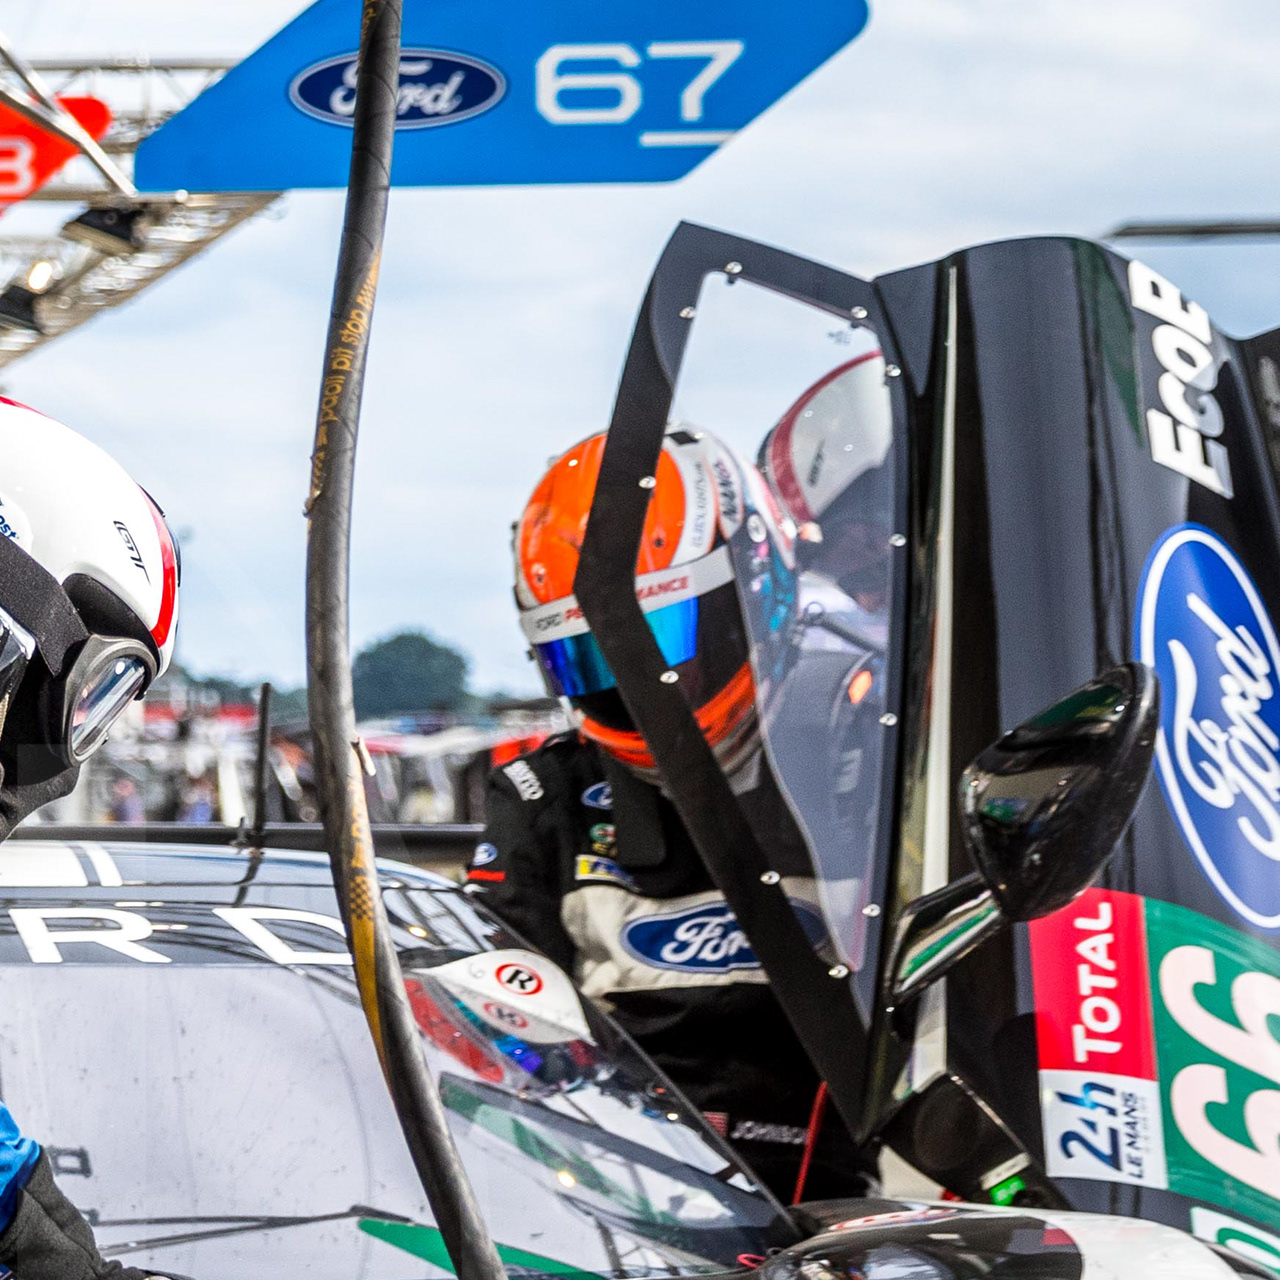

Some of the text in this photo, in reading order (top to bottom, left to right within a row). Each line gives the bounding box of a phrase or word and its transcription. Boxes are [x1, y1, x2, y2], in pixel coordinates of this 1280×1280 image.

[329, 59, 465, 116] Frd
[535, 41, 744, 125] 67
[321, 308, 369, 423] paoli pit stop
[661, 915, 752, 962] For
[1072, 903, 1123, 1062] TOTAL
[1124, 1091, 1145, 1180] LE MANS
